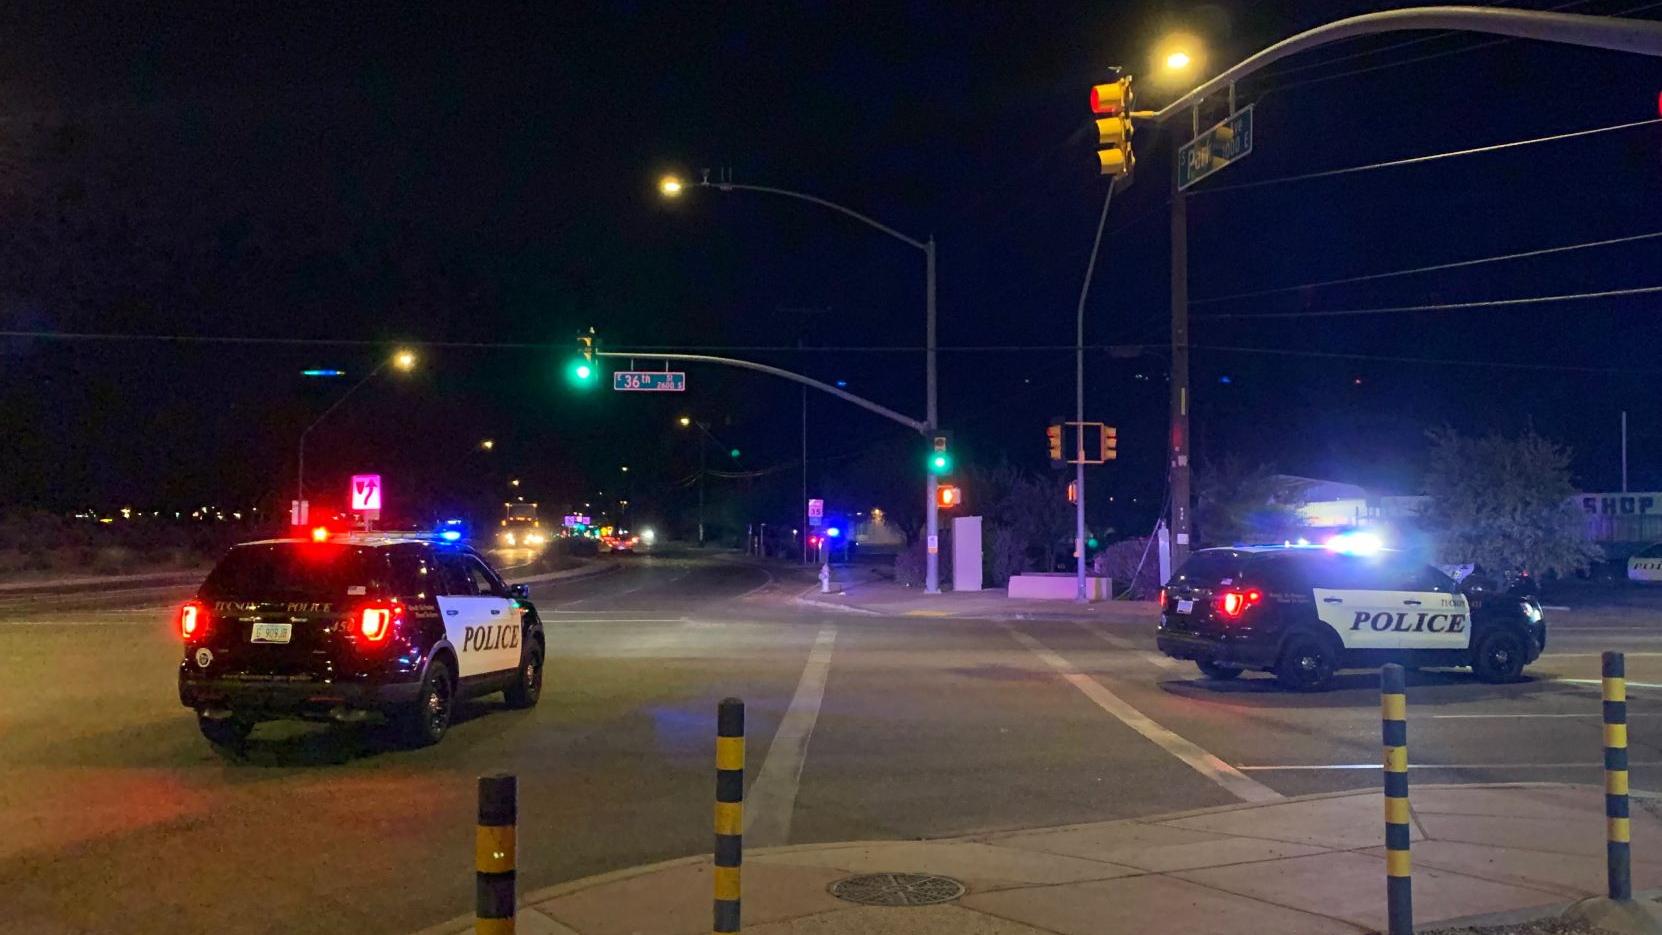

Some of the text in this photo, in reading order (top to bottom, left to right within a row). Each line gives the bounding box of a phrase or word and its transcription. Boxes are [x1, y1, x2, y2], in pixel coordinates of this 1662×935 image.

[624, 374, 651, 389] 36th
[1582, 497, 1654, 514] SHOP
[1350, 611, 1466, 633] POLICE
[463, 624, 519, 652] POLICE
